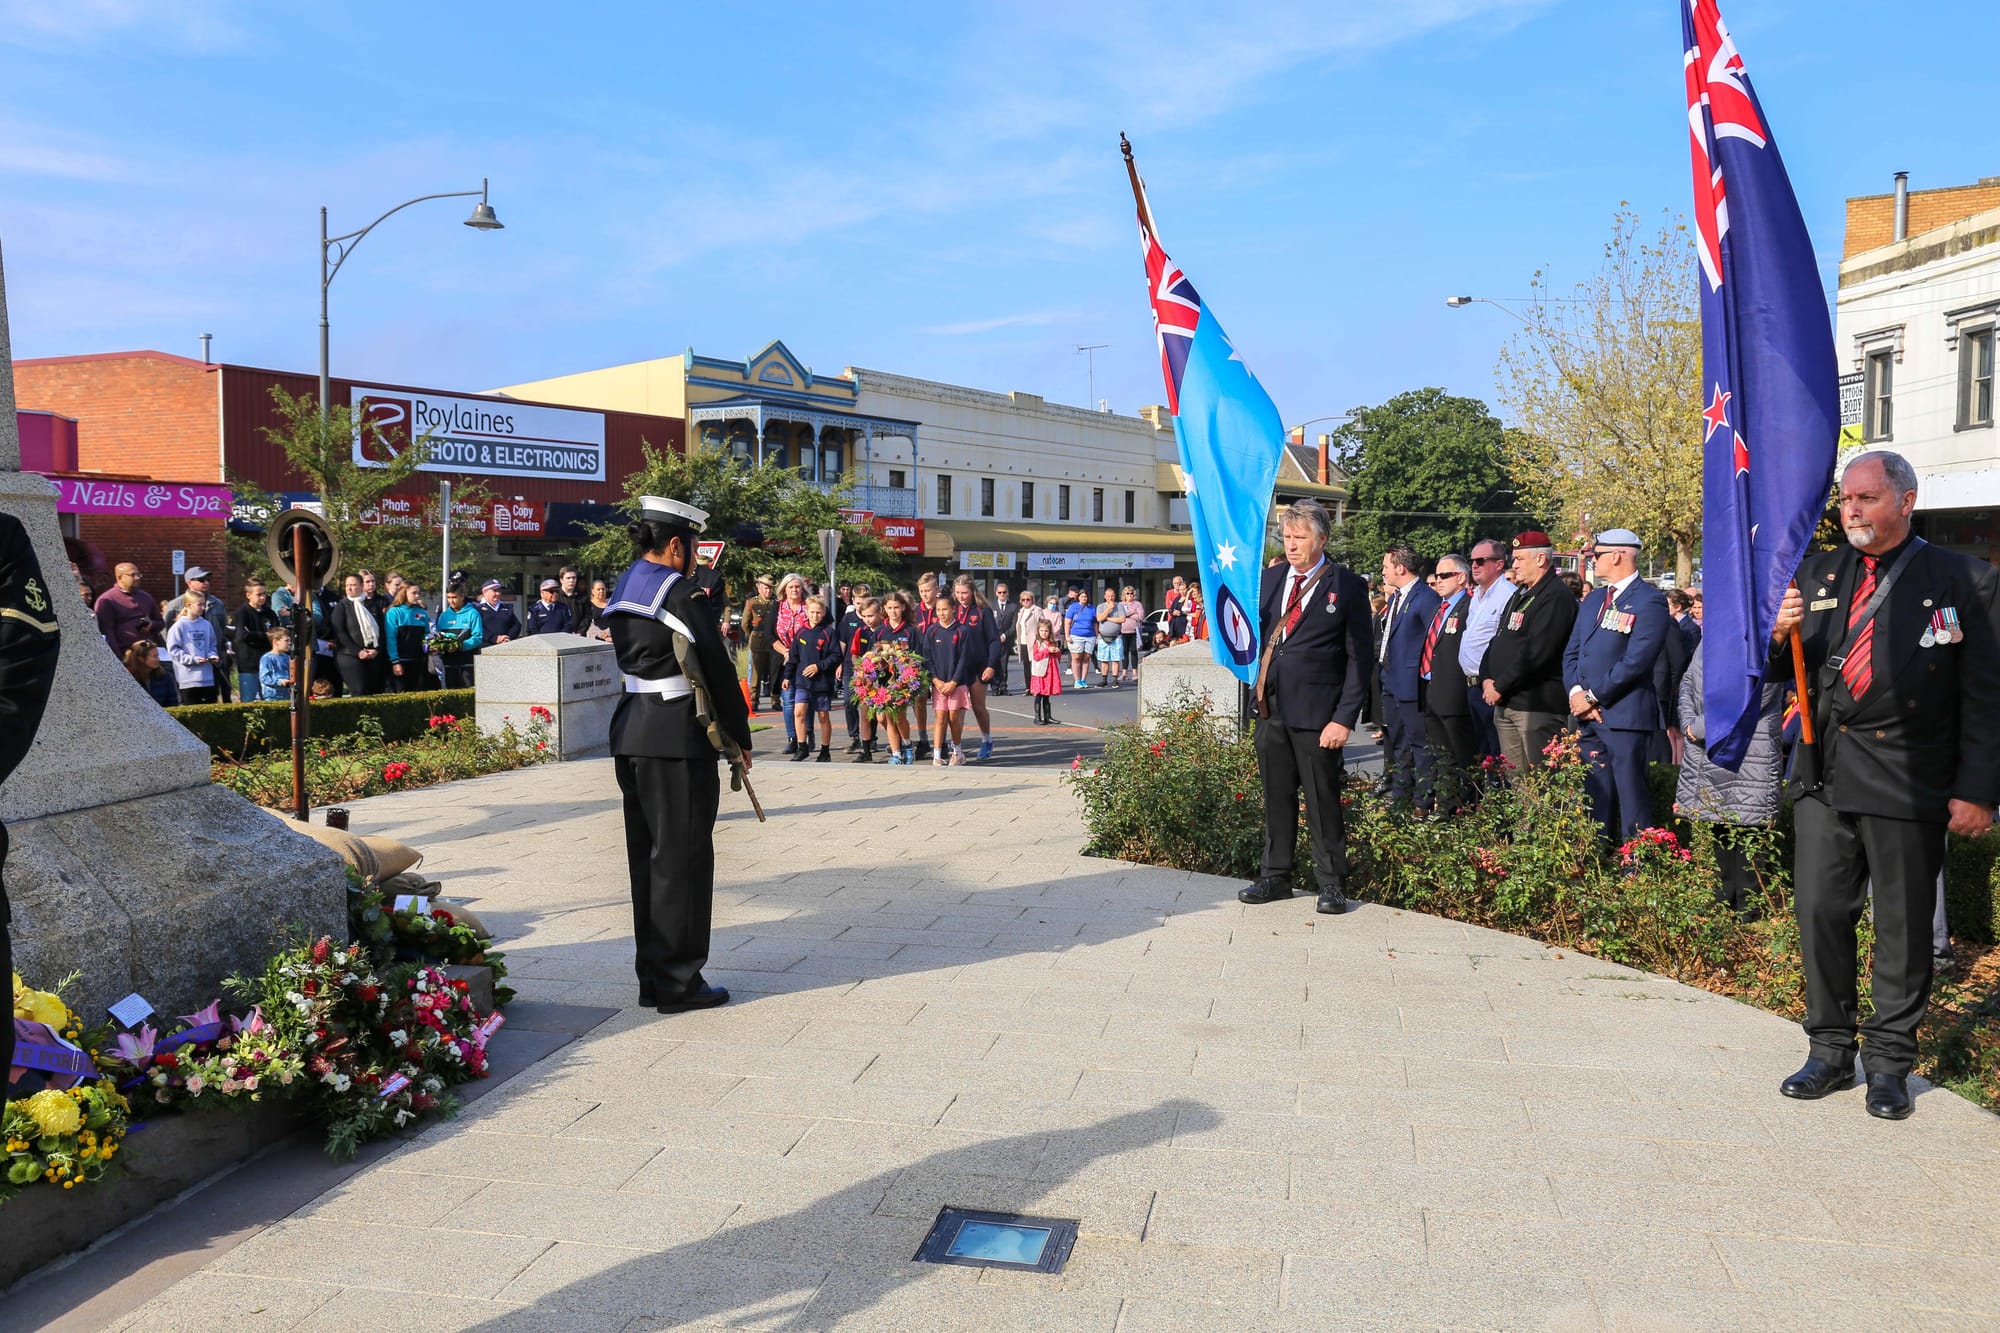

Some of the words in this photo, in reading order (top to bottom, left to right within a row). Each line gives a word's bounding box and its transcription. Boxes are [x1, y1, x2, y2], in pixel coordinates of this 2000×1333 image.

[1840, 385, 1863, 399] ATTOOS
[1844, 398, 1863, 413] BODY
[416, 400, 514, 434] Roylaines
[481, 445, 491, 463] &
[495, 446, 597, 471] ELECTRONICS
[69, 482, 135, 508] Nails
[144, 485, 171, 509] &
[176, 487, 221, 516] Spa
[382, 498, 410, 512] Photo
[513, 504, 533, 518] Copy
[513, 518, 540, 531] Centre
[886, 526, 915, 537] RENTALS
[700, 547, 714, 555] GIVE
